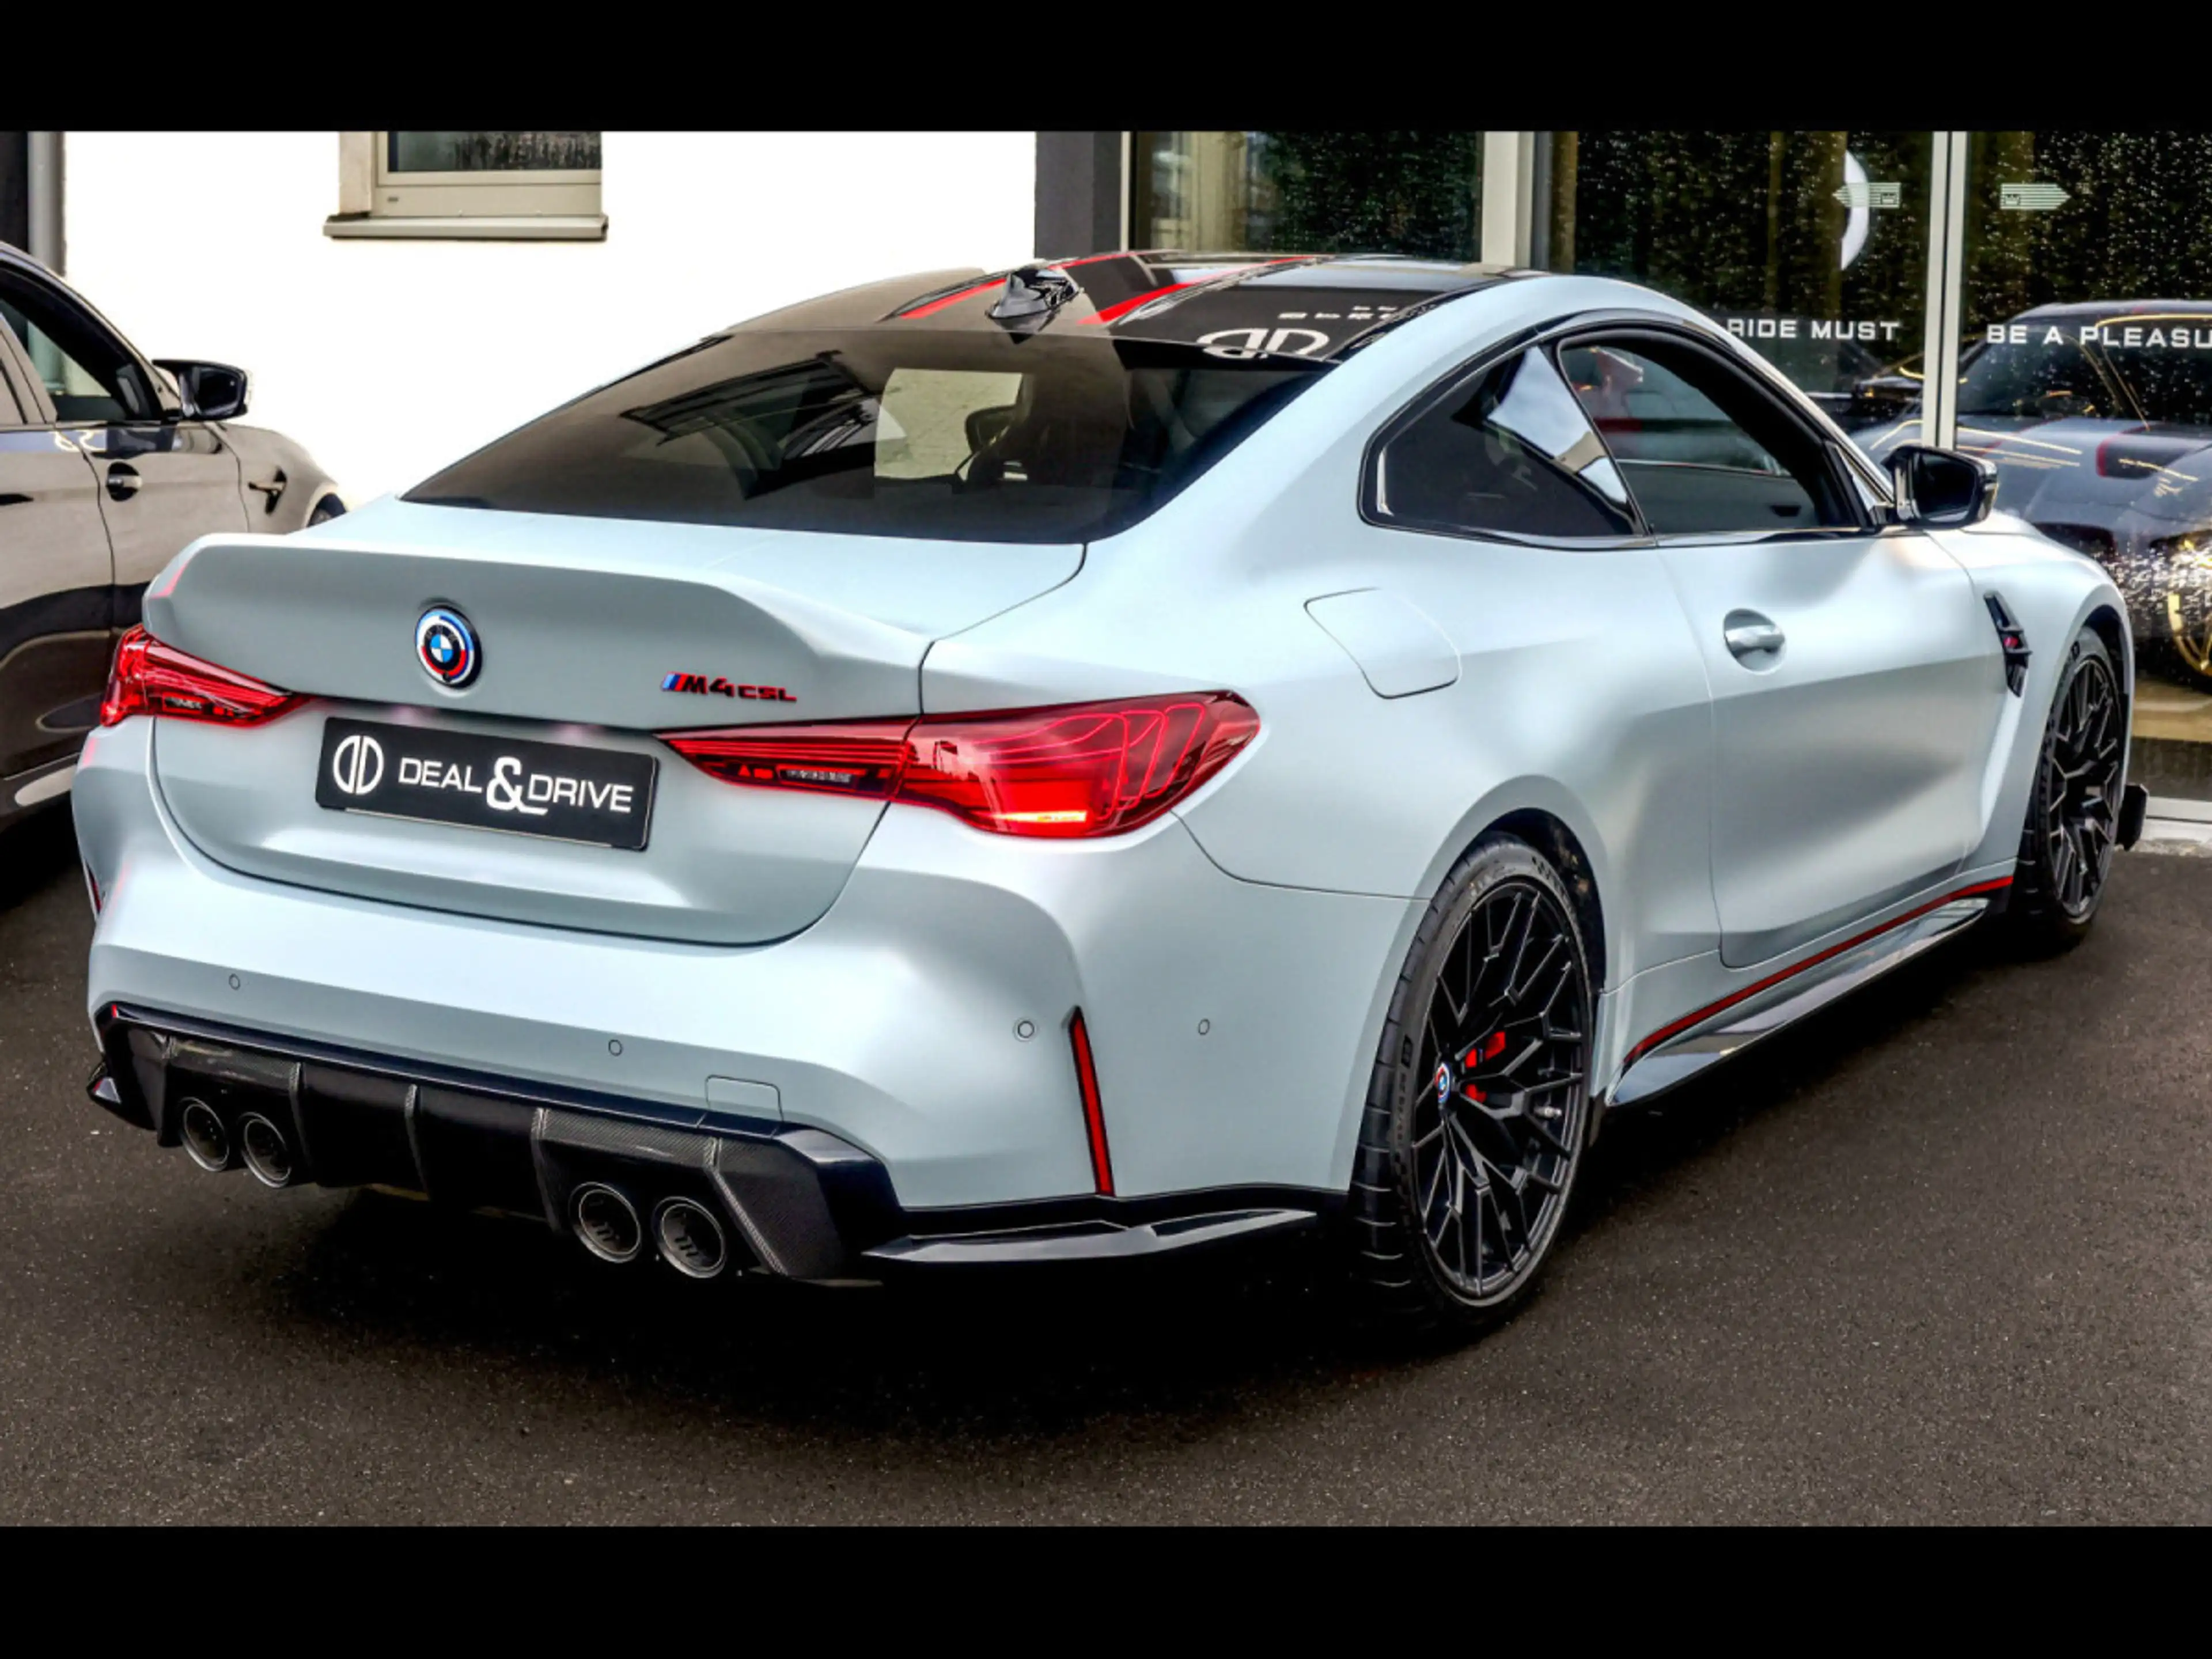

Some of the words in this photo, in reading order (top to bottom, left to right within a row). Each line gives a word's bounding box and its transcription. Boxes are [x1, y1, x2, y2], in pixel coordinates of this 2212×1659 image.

[1728, 318, 1797, 338] RIDE
[1810, 320, 1899, 342] MUST
[1986, 324, 2028, 344] BE
[2043, 325, 2064, 346] A
[2080, 326, 2212, 350] PLEASU
[398, 757, 483, 794] DEAL
[486, 756, 548, 816] &
[527, 773, 634, 813] DRIVE
